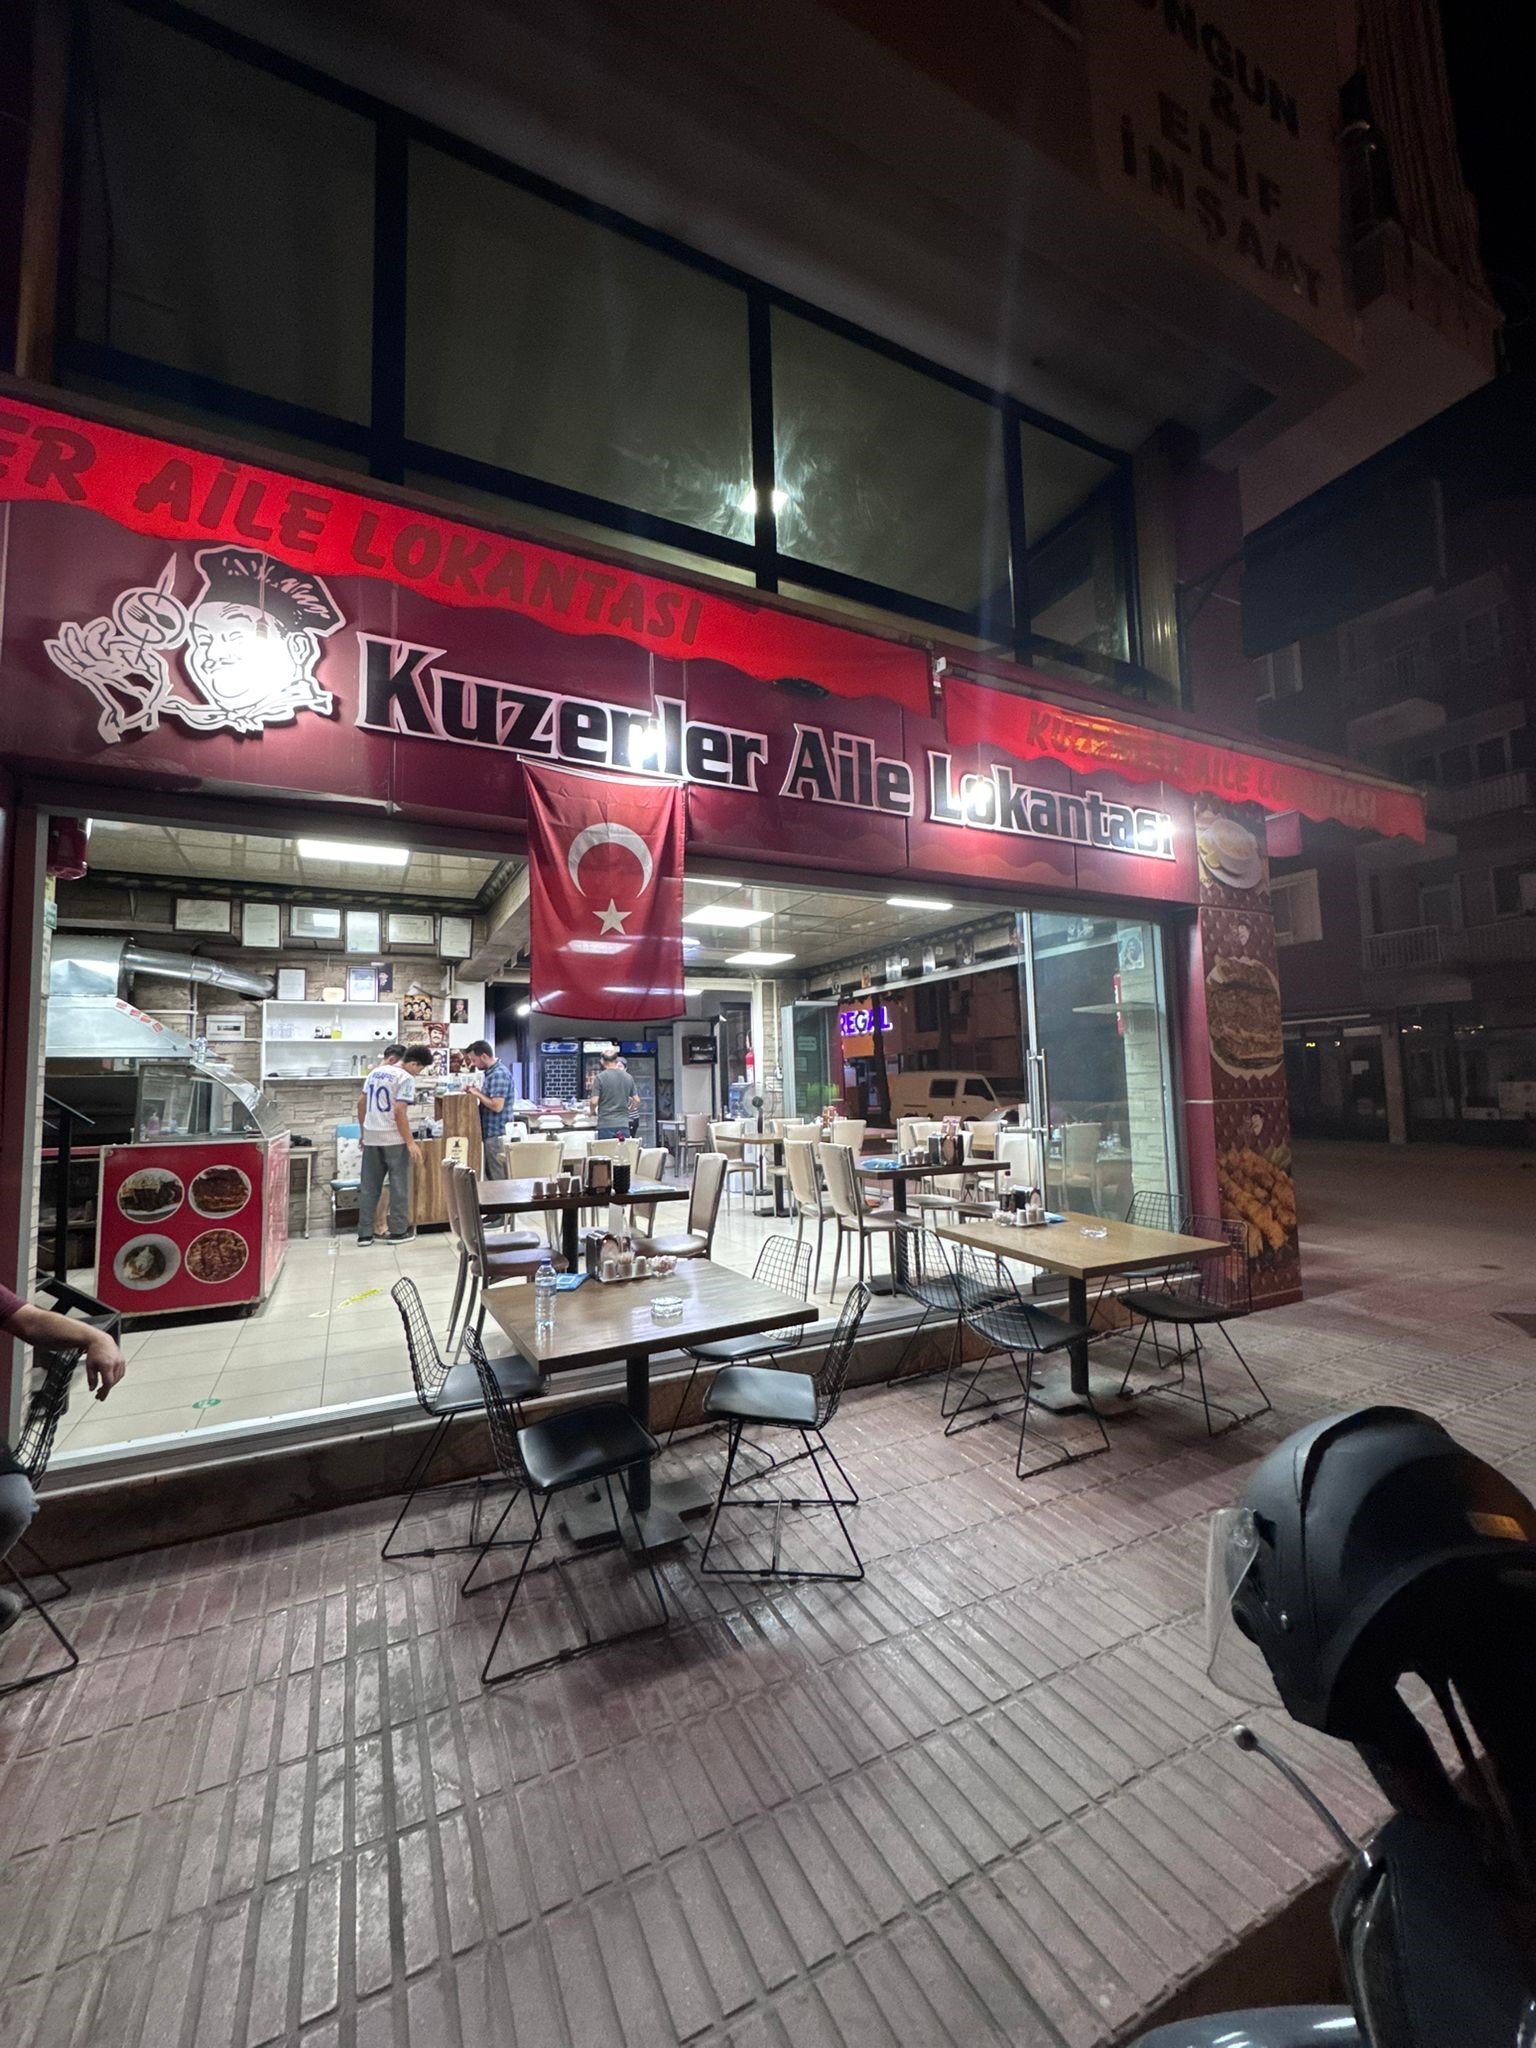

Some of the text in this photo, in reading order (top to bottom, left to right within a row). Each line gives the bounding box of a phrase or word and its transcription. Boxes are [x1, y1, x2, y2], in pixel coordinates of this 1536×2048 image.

[1133, 0, 1300, 139] NGUN
[133, 459, 333, 552] AİLE
[352, 511, 703, 646] LOKANTASI
[779, 723, 914, 816] Aile
[369, 1084, 391, 1112] 10
